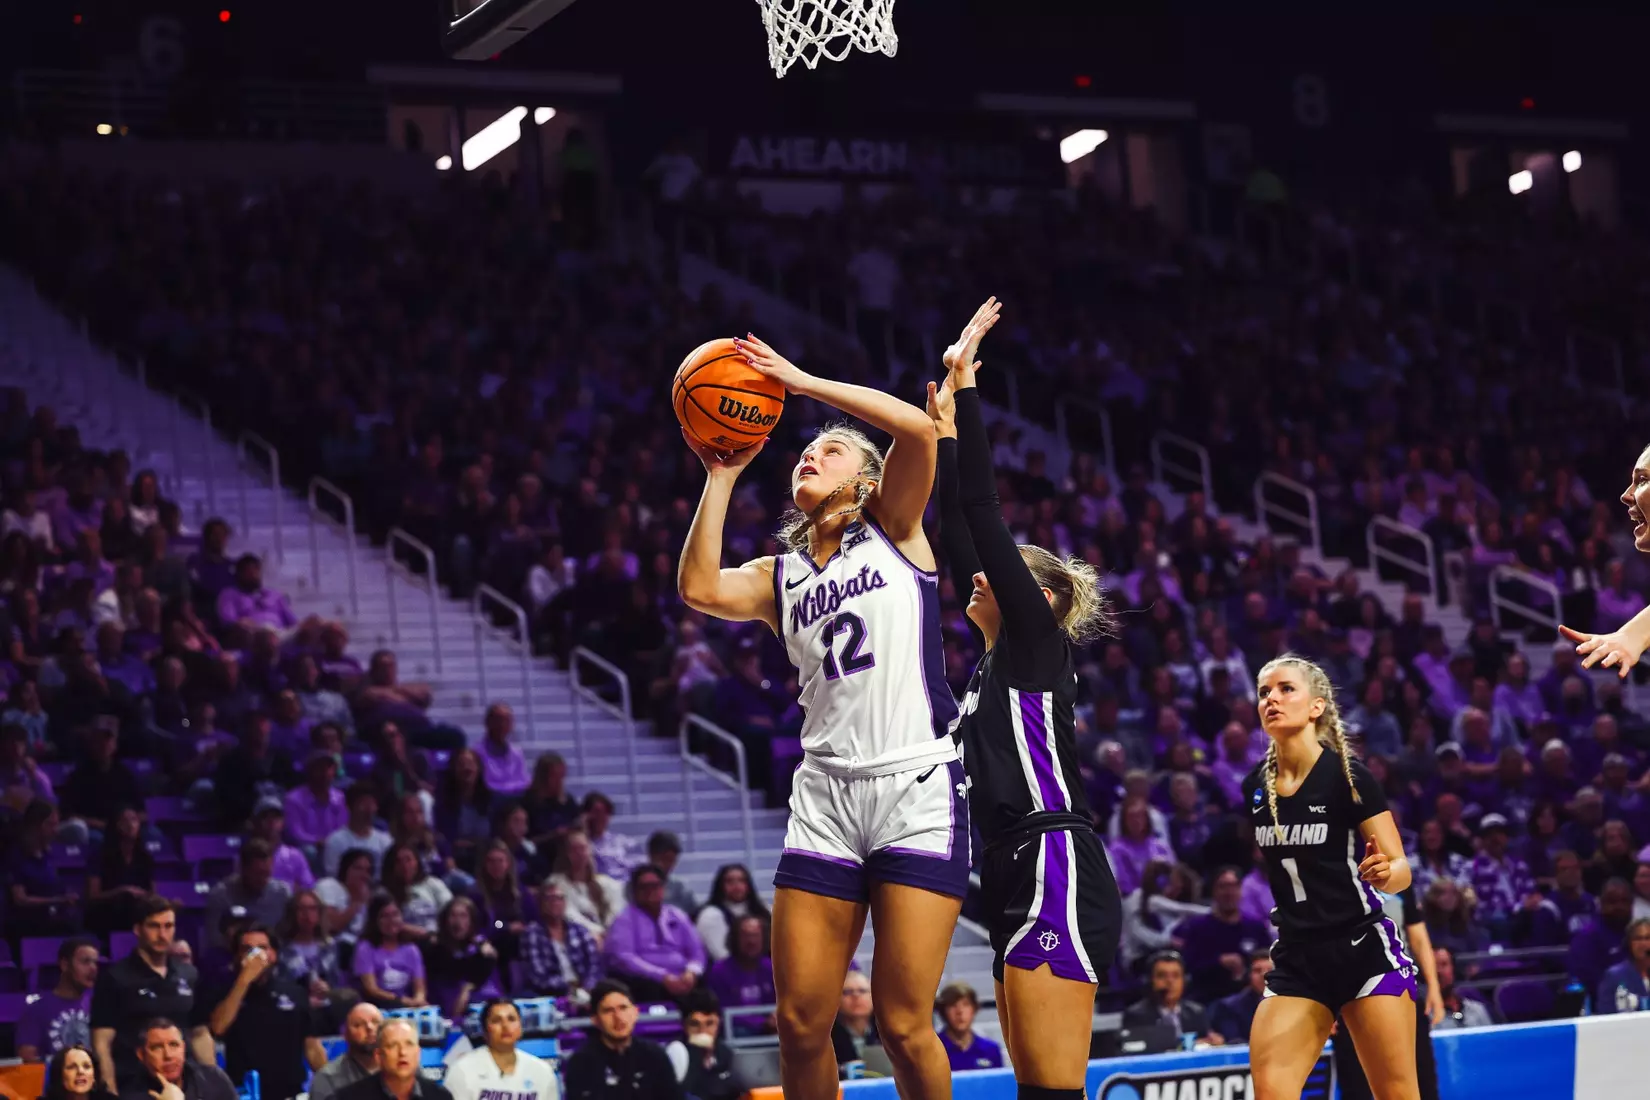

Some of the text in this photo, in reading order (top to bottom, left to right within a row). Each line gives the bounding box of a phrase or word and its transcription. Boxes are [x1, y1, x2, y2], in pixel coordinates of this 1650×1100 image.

[1293, 73, 1328, 127] 8
[730, 136, 907, 172] AHEARN
[719, 395, 777, 426] Wilson
[821, 610, 875, 680] 12
[1281, 857, 1307, 903] 1
[1144, 1074, 1255, 1100] MARC
